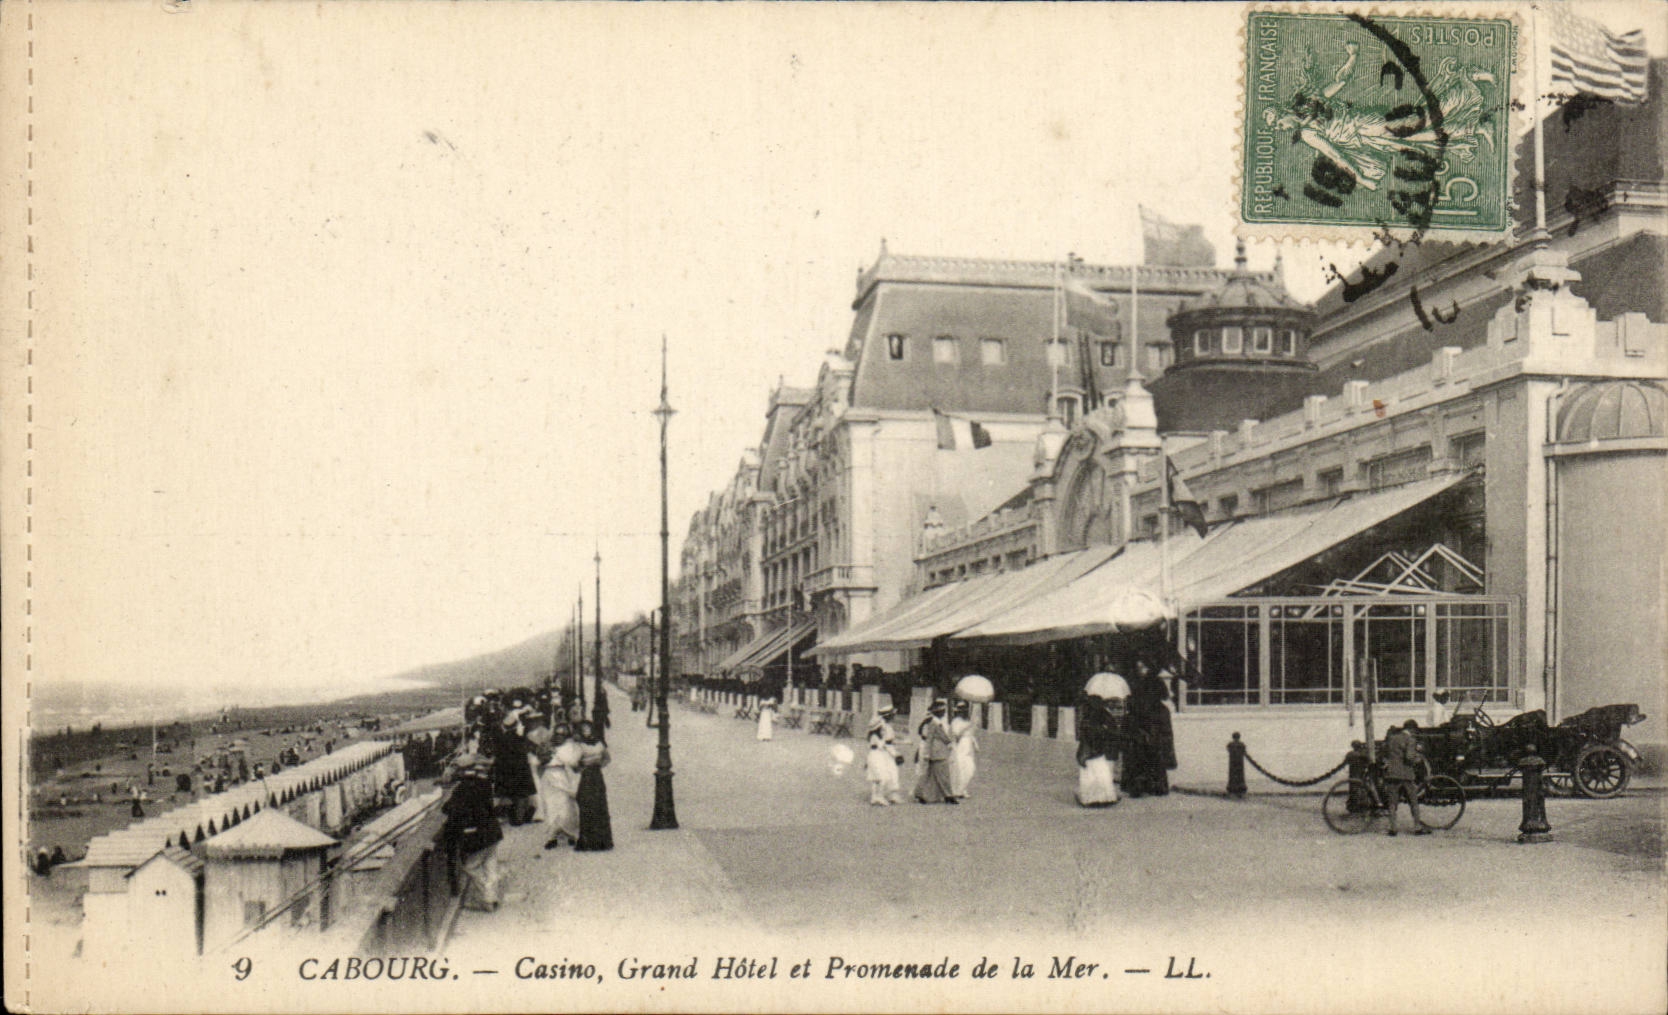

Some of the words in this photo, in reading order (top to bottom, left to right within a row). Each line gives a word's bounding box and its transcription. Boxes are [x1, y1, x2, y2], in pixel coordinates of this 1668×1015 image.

[1258, 20, 1279, 101] FRANÇAISE
[1411, 26, 1496, 46] POSTES
[1254, 128, 1274, 213] REPUBLIQUE
